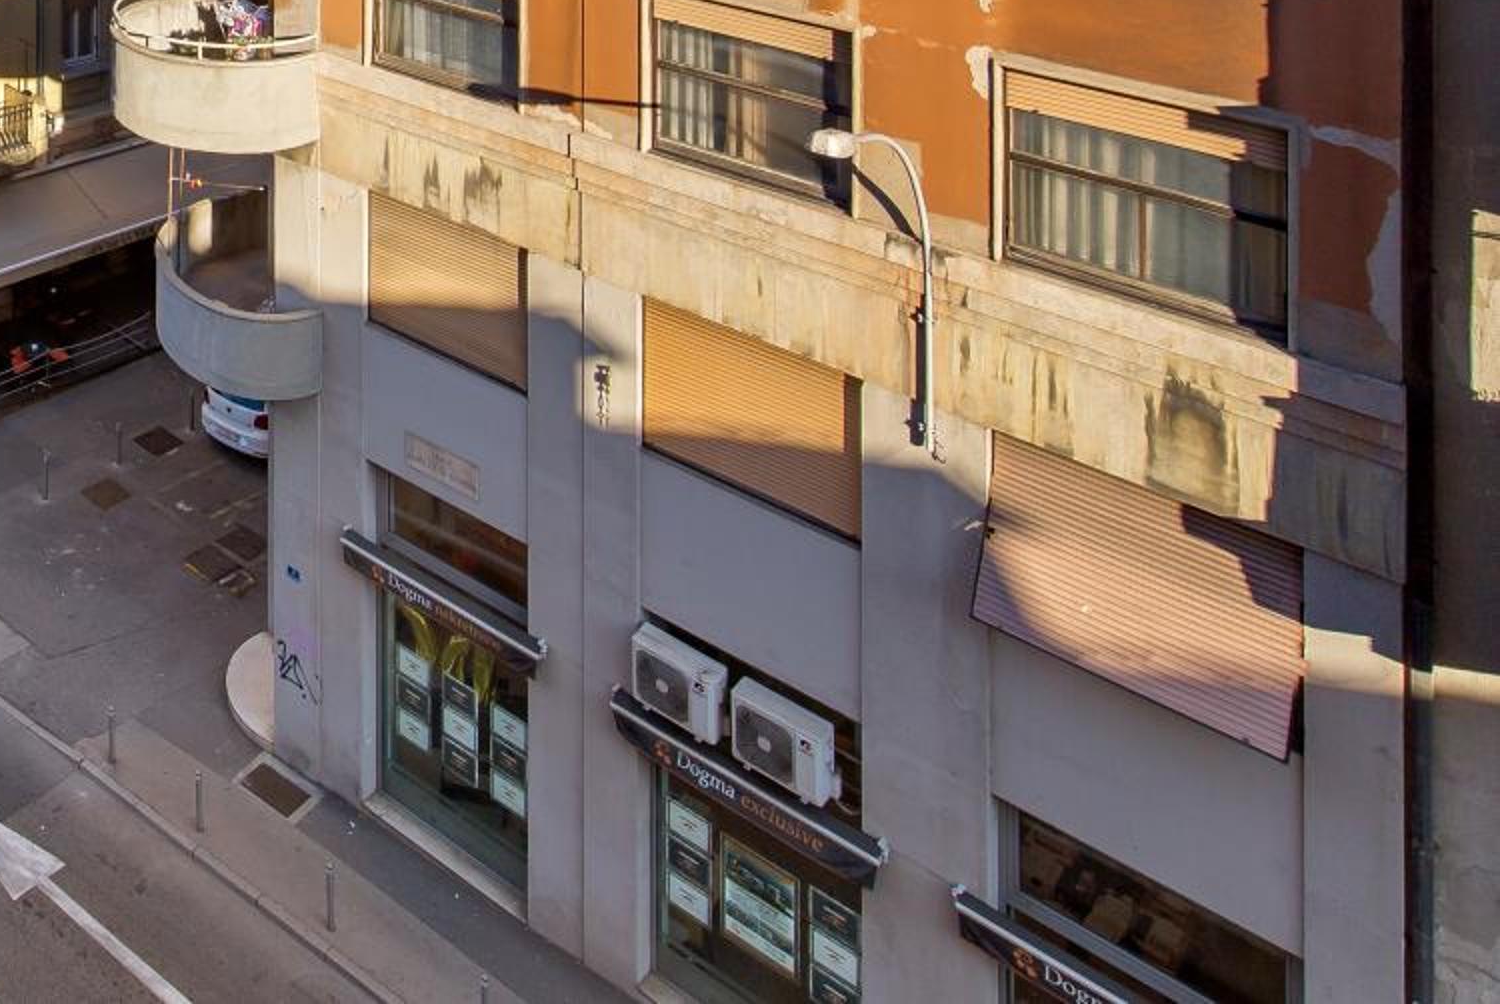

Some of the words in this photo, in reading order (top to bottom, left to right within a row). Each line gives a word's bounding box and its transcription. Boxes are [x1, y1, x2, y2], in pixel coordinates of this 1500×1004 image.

[388, 573, 432, 610] Dogma
[676, 750, 736, 800] Dogma
[740, 796, 825, 853] exclusive
